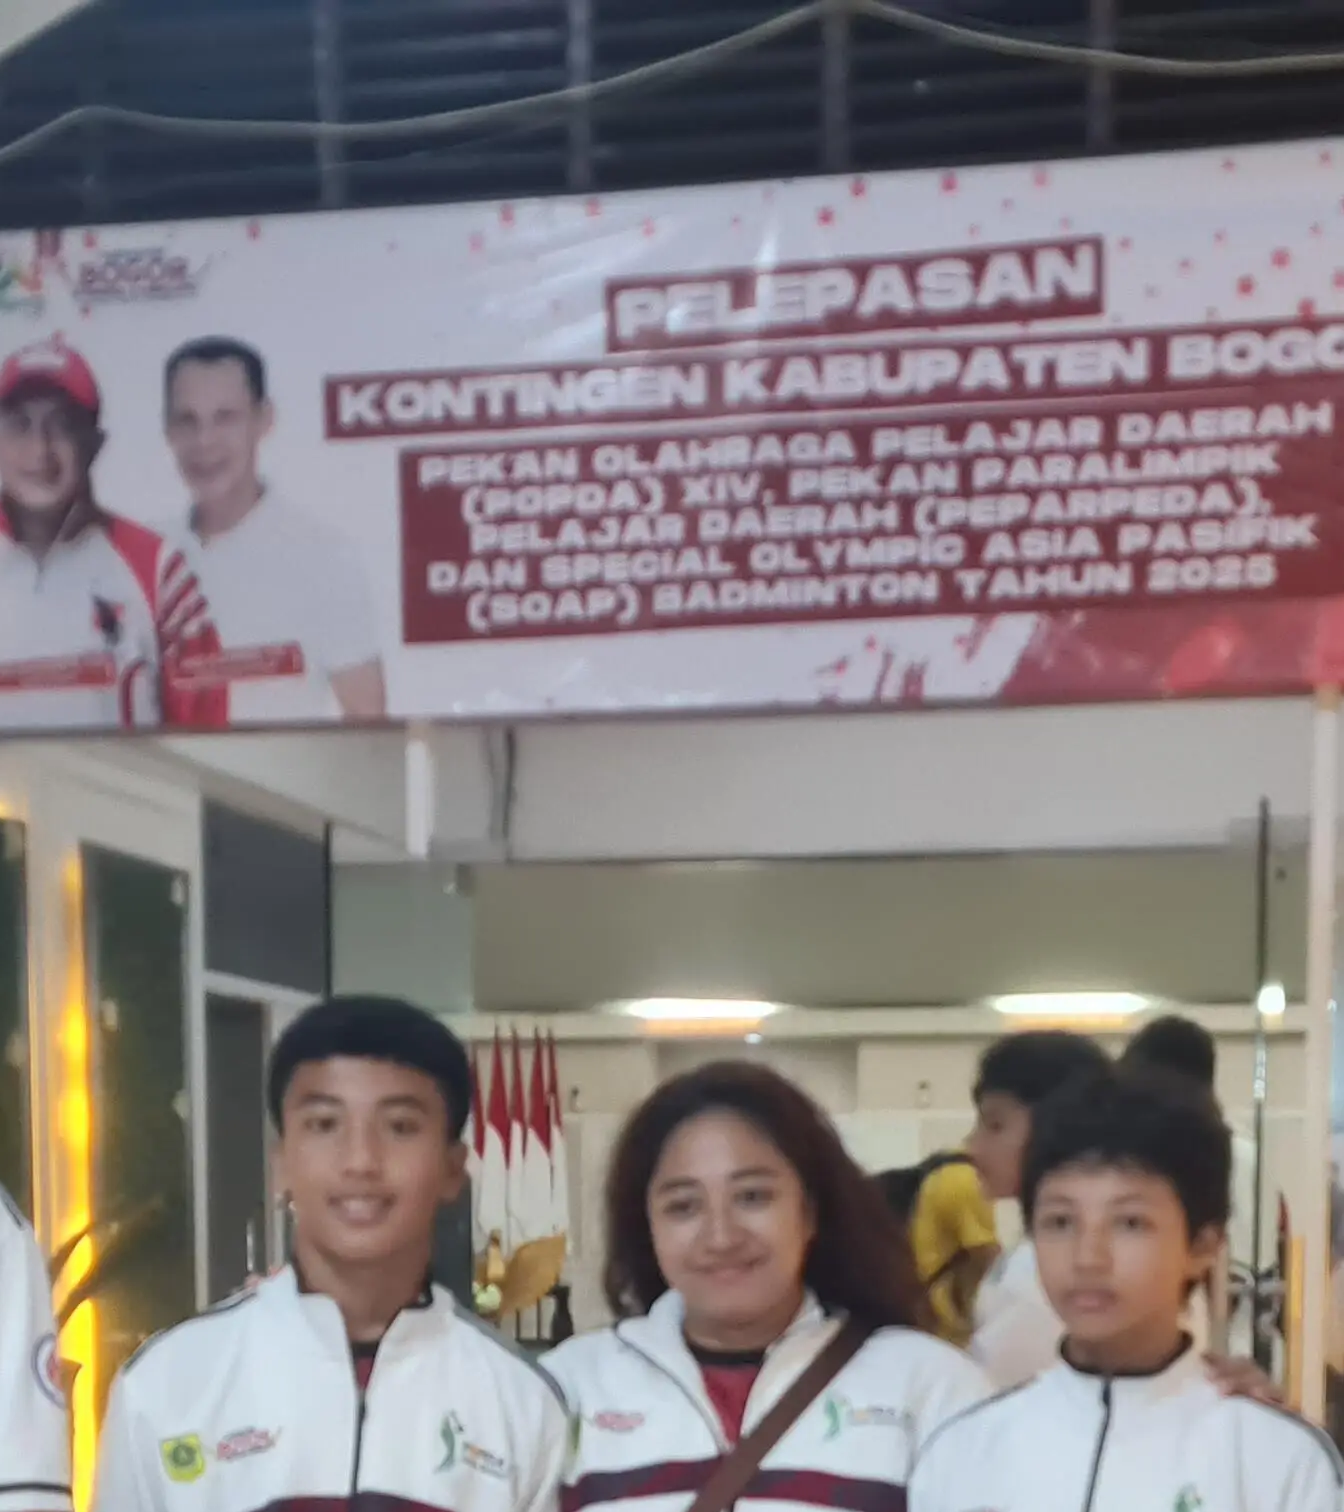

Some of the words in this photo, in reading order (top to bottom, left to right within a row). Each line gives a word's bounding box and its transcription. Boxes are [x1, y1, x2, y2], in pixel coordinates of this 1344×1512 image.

[618, 245, 1093, 338] PELEPASAN
[338, 364, 705, 427] KONTINGEN
[723, 337, 1149, 400] KABUPATEN
[418, 449, 579, 486] PEKAN
[592, 431, 855, 474] OLAHRAGA
[872, 415, 1102, 457] PELAJAR
[1117, 401, 1334, 444] DAERAH
[461, 476, 664, 524] (POPDA)
[789, 460, 958, 499] PEKAN
[971, 443, 1281, 492] PARALIMPIK
[427, 559, 527, 593] DAN
[541, 547, 734, 587] SPECIAL
[750, 534, 965, 574] OLYMPIC
[983, 525, 1100, 563] ASIA
[1118, 514, 1317, 556] PASIFIK
[470, 514, 685, 553] PELAJAR
[699, 502, 898, 542] DAERAH
[467, 582, 641, 633] (SOAP)
[653, 569, 938, 615] BADMINTON
[956, 560, 1132, 600] TAHUN
